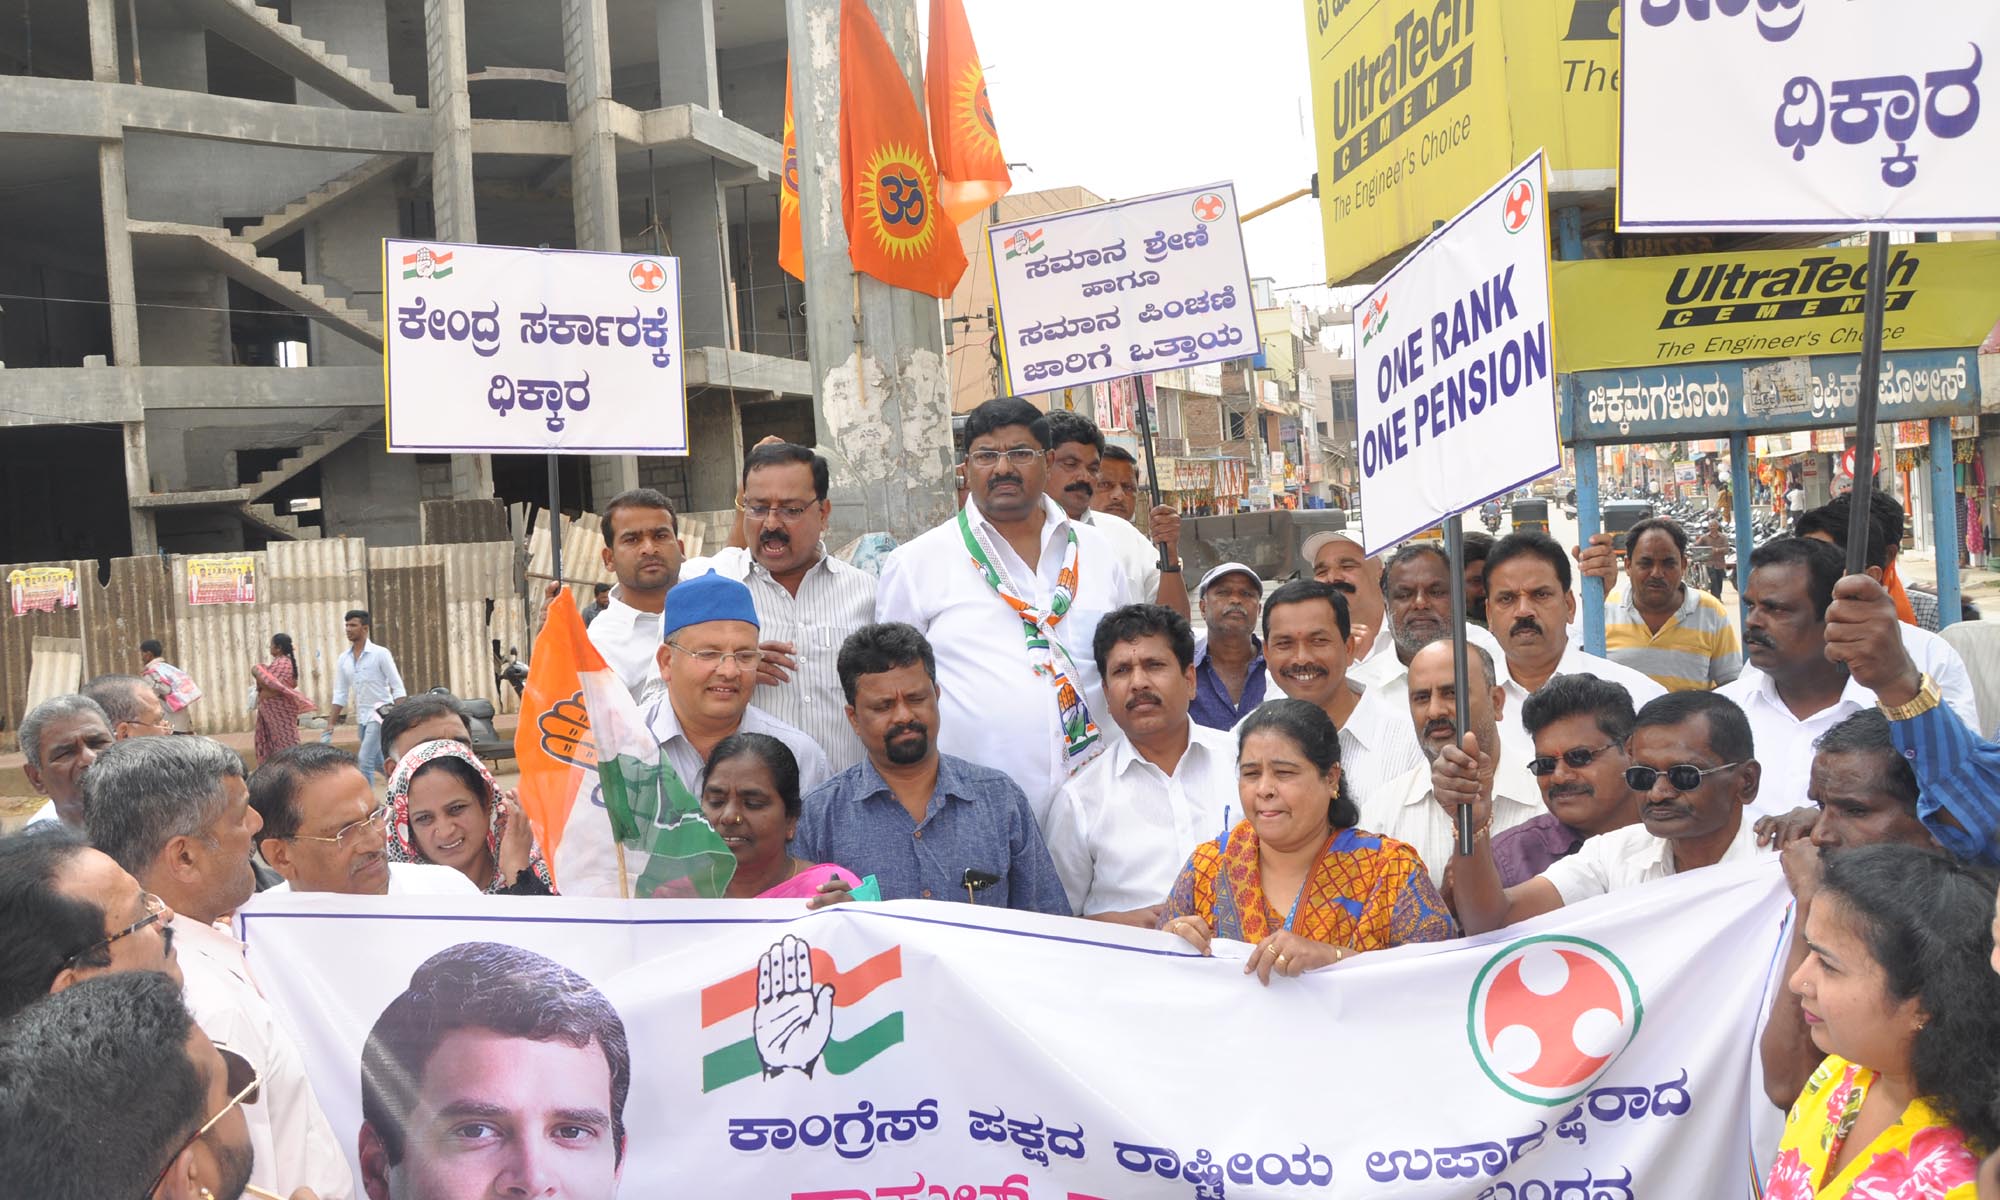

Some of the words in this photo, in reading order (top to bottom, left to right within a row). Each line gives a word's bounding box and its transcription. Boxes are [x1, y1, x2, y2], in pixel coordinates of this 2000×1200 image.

[1334, 0, 1475, 140] UltraTech
[1341, 56, 1464, 172] CEMENT
[1774, 42, 1982, 188] ಧಿಕ್ಕಾರ
[1333, 193, 1351, 224] The
[1355, 148, 1415, 210] Engineer's
[1421, 113, 1471, 167] Choice
[1025, 238, 1127, 279] ಸಮಾನ
[1144, 223, 1209, 263] ಶ್ರೇಣಿ
[1665, 250, 1920, 306] UltraTech
[1018, 305, 1122, 347] ಸಮಾನ
[1138, 285, 1237, 323] ಪಿಂಚಣಿ
[1082, 271, 1160, 298] ಹಾಗೂ
[1673, 294, 1901, 326] CEMENT
[398, 296, 500, 357] ಕೇಂದ್ರ
[520, 302, 671, 369] ಸರ್ಕಾರಕ್ಕೆ
[1023, 343, 1113, 382] ಜಾರಿಗೆ
[1130, 323, 1243, 363] ಒತ್ತಾಯ
[1377, 327, 1424, 404] ONE
[1432, 264, 1518, 368] RANK
[1657, 341, 1696, 360] The
[1705, 331, 1821, 354] Engineer's
[1830, 326, 1905, 344] Chce
[487, 369, 591, 433] ಧಿಕ್ಕಾರ
[1362, 408, 1408, 479] ONE
[1416, 321, 1547, 448] PENSION
[1588, 371, 1729, 435] ಚಿಕ್ಕಮಗಳೂರು
[728, 1098, 939, 1160] ಕಾಂಗ್ರೆಸ್
[969, 1104, 1086, 1167] ಪಕ್ಷದ
